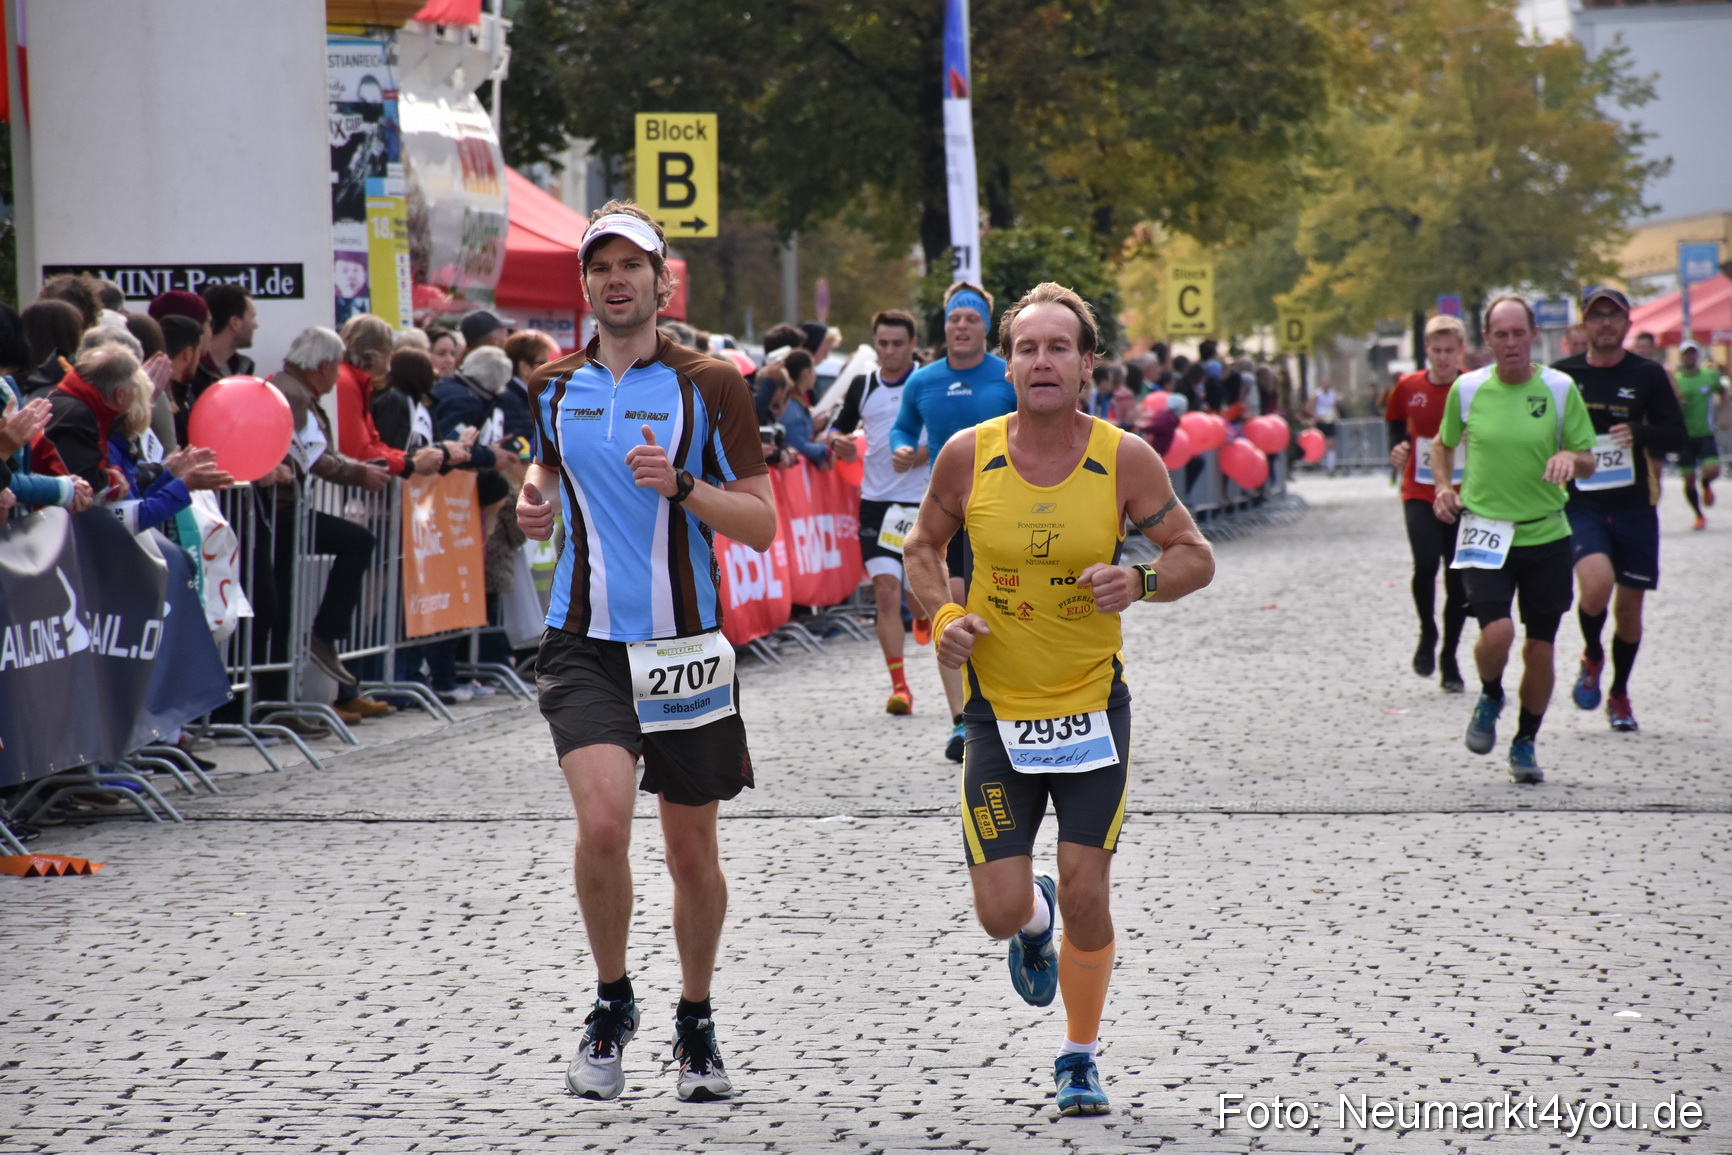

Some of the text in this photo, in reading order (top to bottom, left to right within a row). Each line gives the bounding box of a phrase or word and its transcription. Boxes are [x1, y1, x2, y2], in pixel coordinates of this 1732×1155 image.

[646, 119, 707, 140] Block
[658, 151, 697, 209] B
[1178, 285, 1201, 318] C
[1287, 319, 1304, 342] D
[647, 412, 669, 421] RACER
[1592, 450, 1624, 468] 752
[1461, 528, 1501, 550] 2276
[992, 572, 1020, 587] Seidl
[1058, 596, 1095, 609] PIZZERIA
[1066, 604, 1091, 616] ELIO
[667, 644, 703, 656] BOCK
[648, 656, 720, 696] 2707
[663, 697, 711, 714] Sebastian
[1014, 713, 1091, 745] 2939
[986, 788, 1012, 826] Run!
[980, 808, 995, 837] Team
